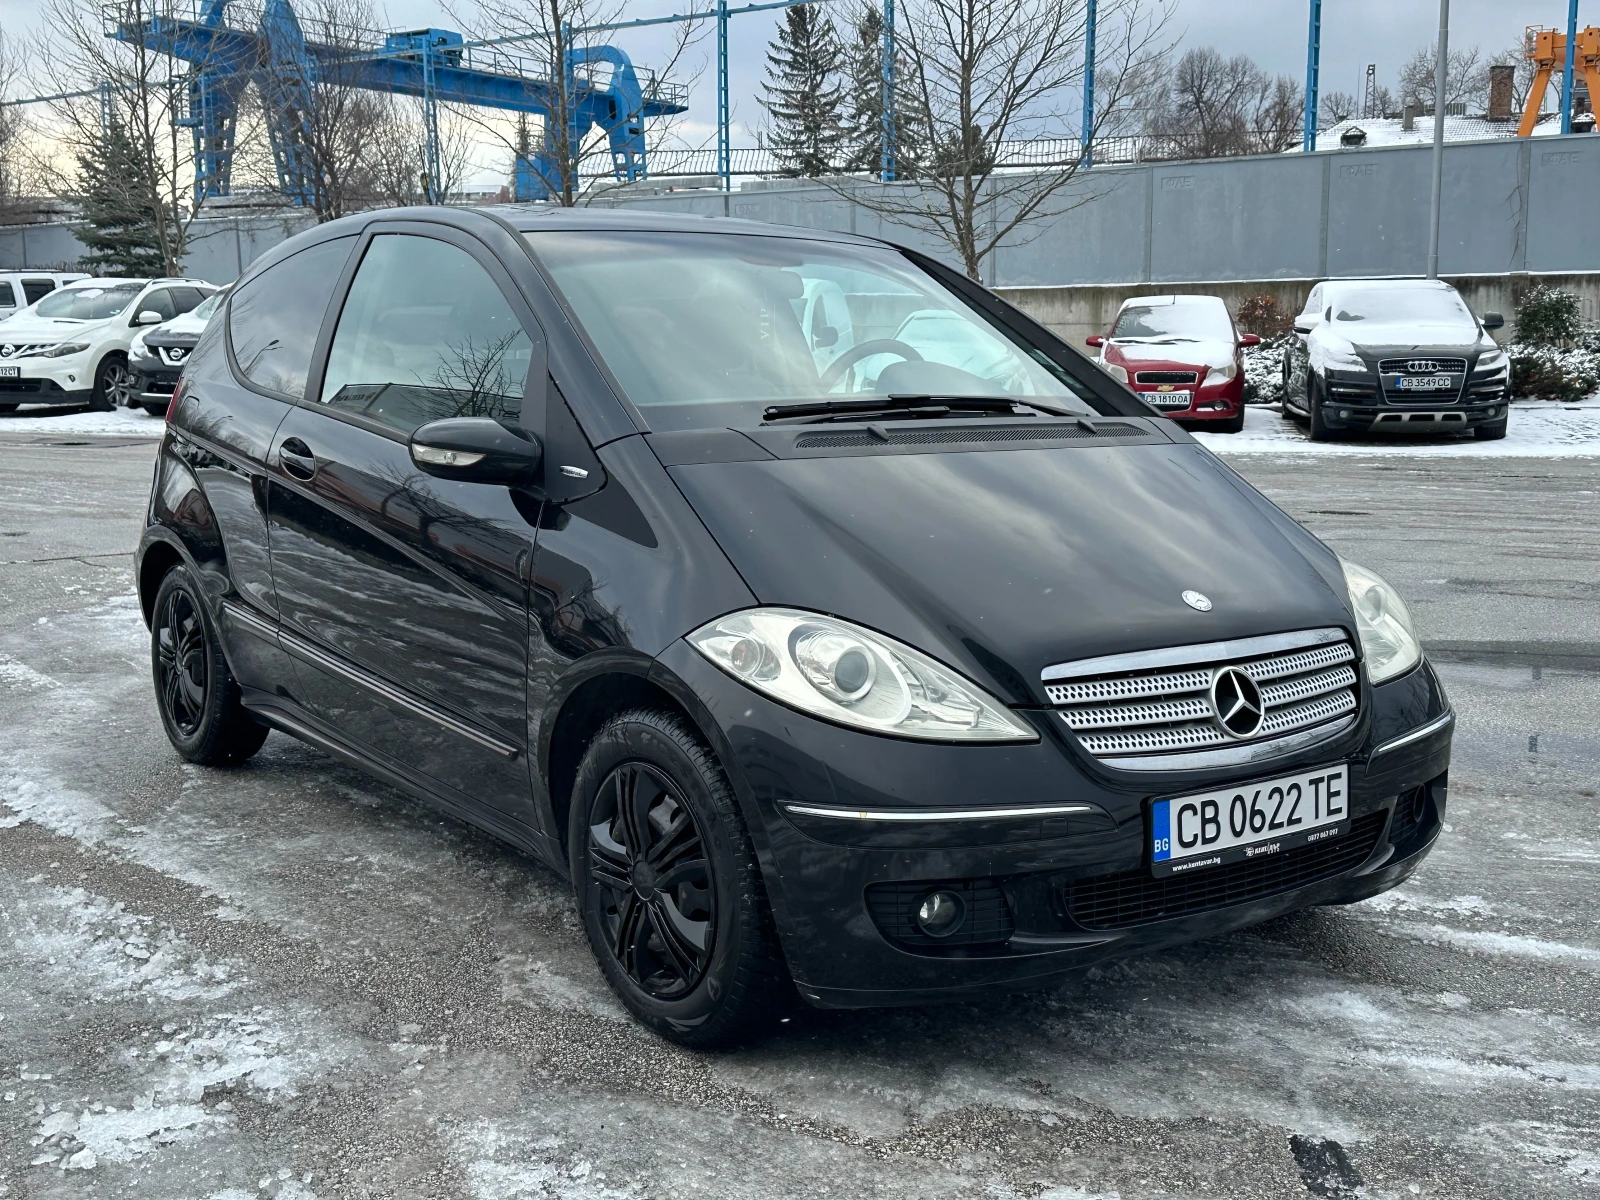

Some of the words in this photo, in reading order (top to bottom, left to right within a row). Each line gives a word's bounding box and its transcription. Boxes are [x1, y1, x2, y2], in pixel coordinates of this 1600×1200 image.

[1401, 378, 1413, 387] CB
[1414, 378, 1436, 387] 3549
[1437, 378, 1450, 387] CC
[1158, 395, 1177, 403] 1810
[1177, 799, 1221, 849] CB
[1229, 782, 1303, 838] 0622
[1308, 772, 1343, 820] TE
[1154, 838, 1169, 853] BG
[1172, 857, 1221, 872] www.kentavar.bg
